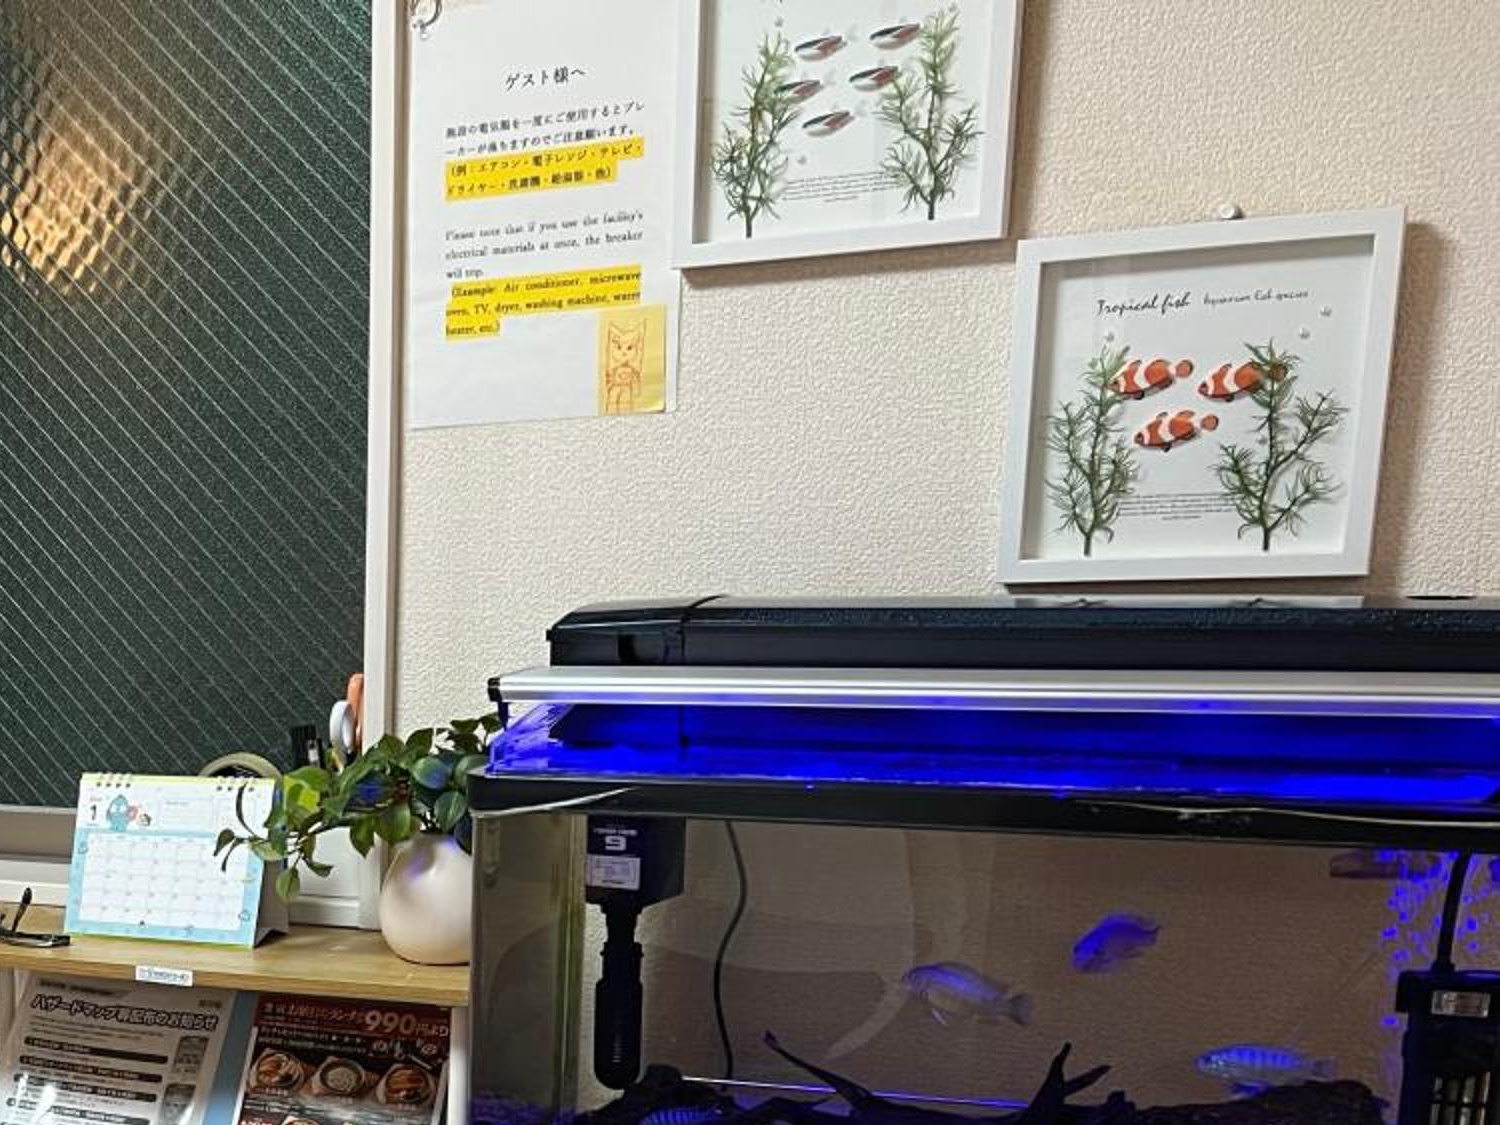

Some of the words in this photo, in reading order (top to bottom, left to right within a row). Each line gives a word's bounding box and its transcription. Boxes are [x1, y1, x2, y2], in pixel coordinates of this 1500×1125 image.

[506, 67, 586, 90] ゲスト様へ
[446, 231, 475, 241] Please
[480, 229, 499, 237] note
[505, 225, 523, 235] that
[528, 222, 535, 232] if
[540, 223, 556, 232] you
[562, 220, 577, 228] use
[583, 215, 598, 225] the
[446, 247, 488, 260] electrical
[493, 241, 535, 255] materials
[540, 241, 549, 250] at
[554, 240, 579, 249] once,
[585, 235, 599, 245] the
[606, 232, 643, 243] breaker
[447, 269, 462, 278] will
[504, 282, 519, 292] Air
[526, 278, 581, 291] conditioner,
[590, 272, 641, 284] microwave
[474, 305, 491, 315] TV,
[494, 302, 522, 313] dryer,
[525, 298, 563, 310] washing
[568, 294, 610, 305] machine,
[614, 292, 640, 301] water
[1097, 293, 1158, 316] Tropical
[1162, 291, 1191, 314] fish
[90, 804, 97, 821] 1
